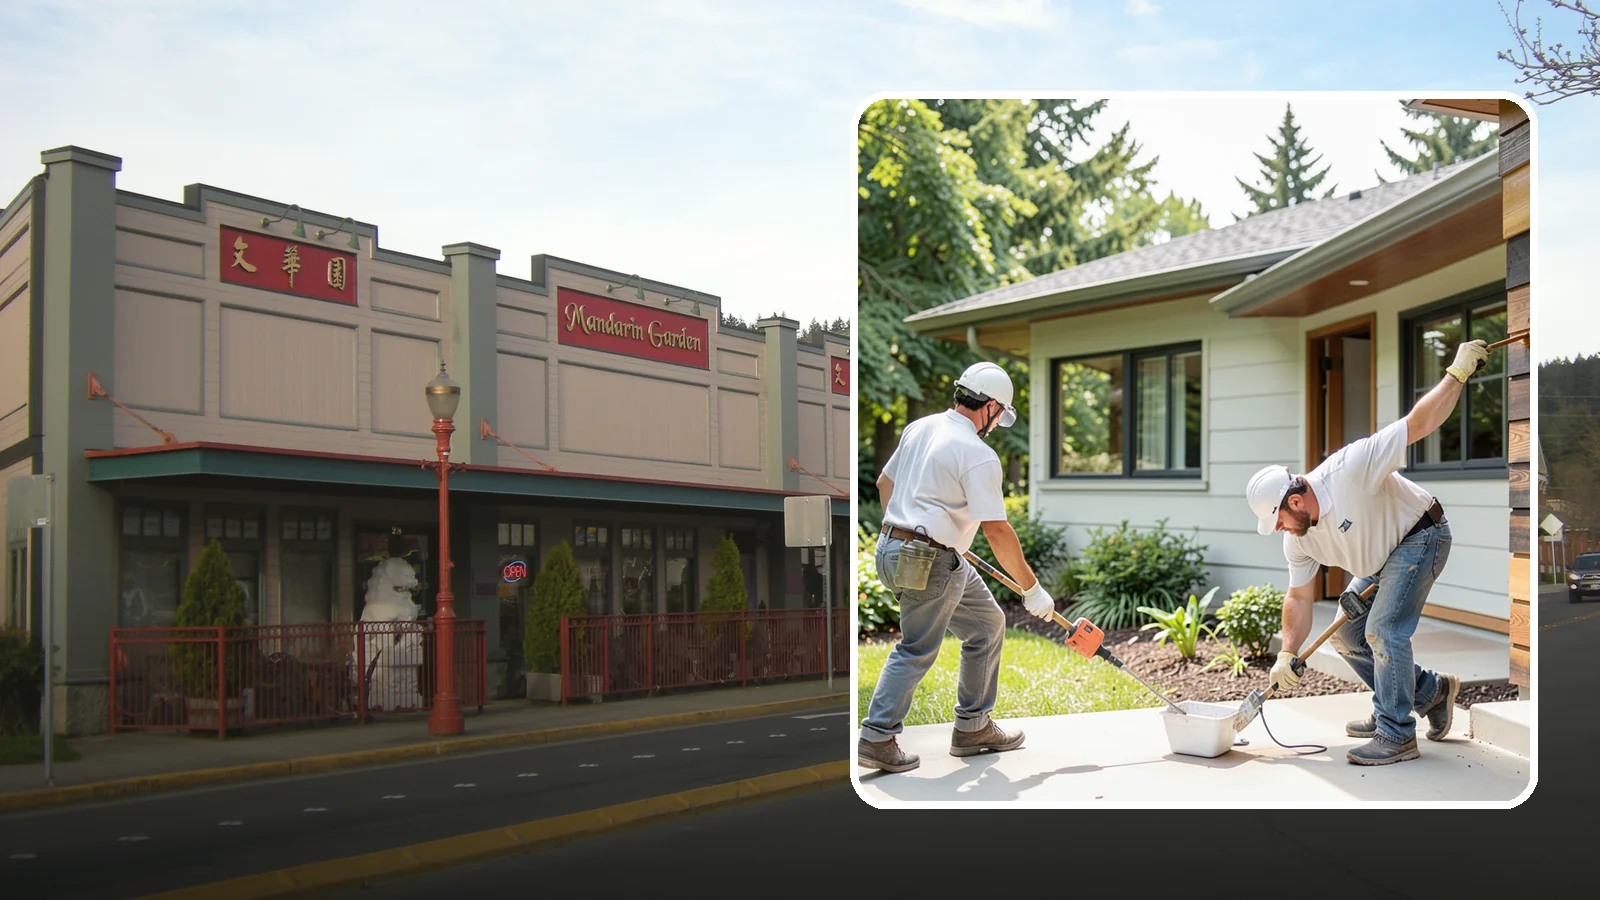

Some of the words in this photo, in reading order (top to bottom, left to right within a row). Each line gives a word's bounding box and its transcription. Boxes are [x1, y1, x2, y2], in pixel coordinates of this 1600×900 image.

[230, 235, 346, 291] 文華園
[564, 302, 644, 341] Mandarin
[648, 320, 701, 352] Garden
[503, 565, 527, 578] OPEN
